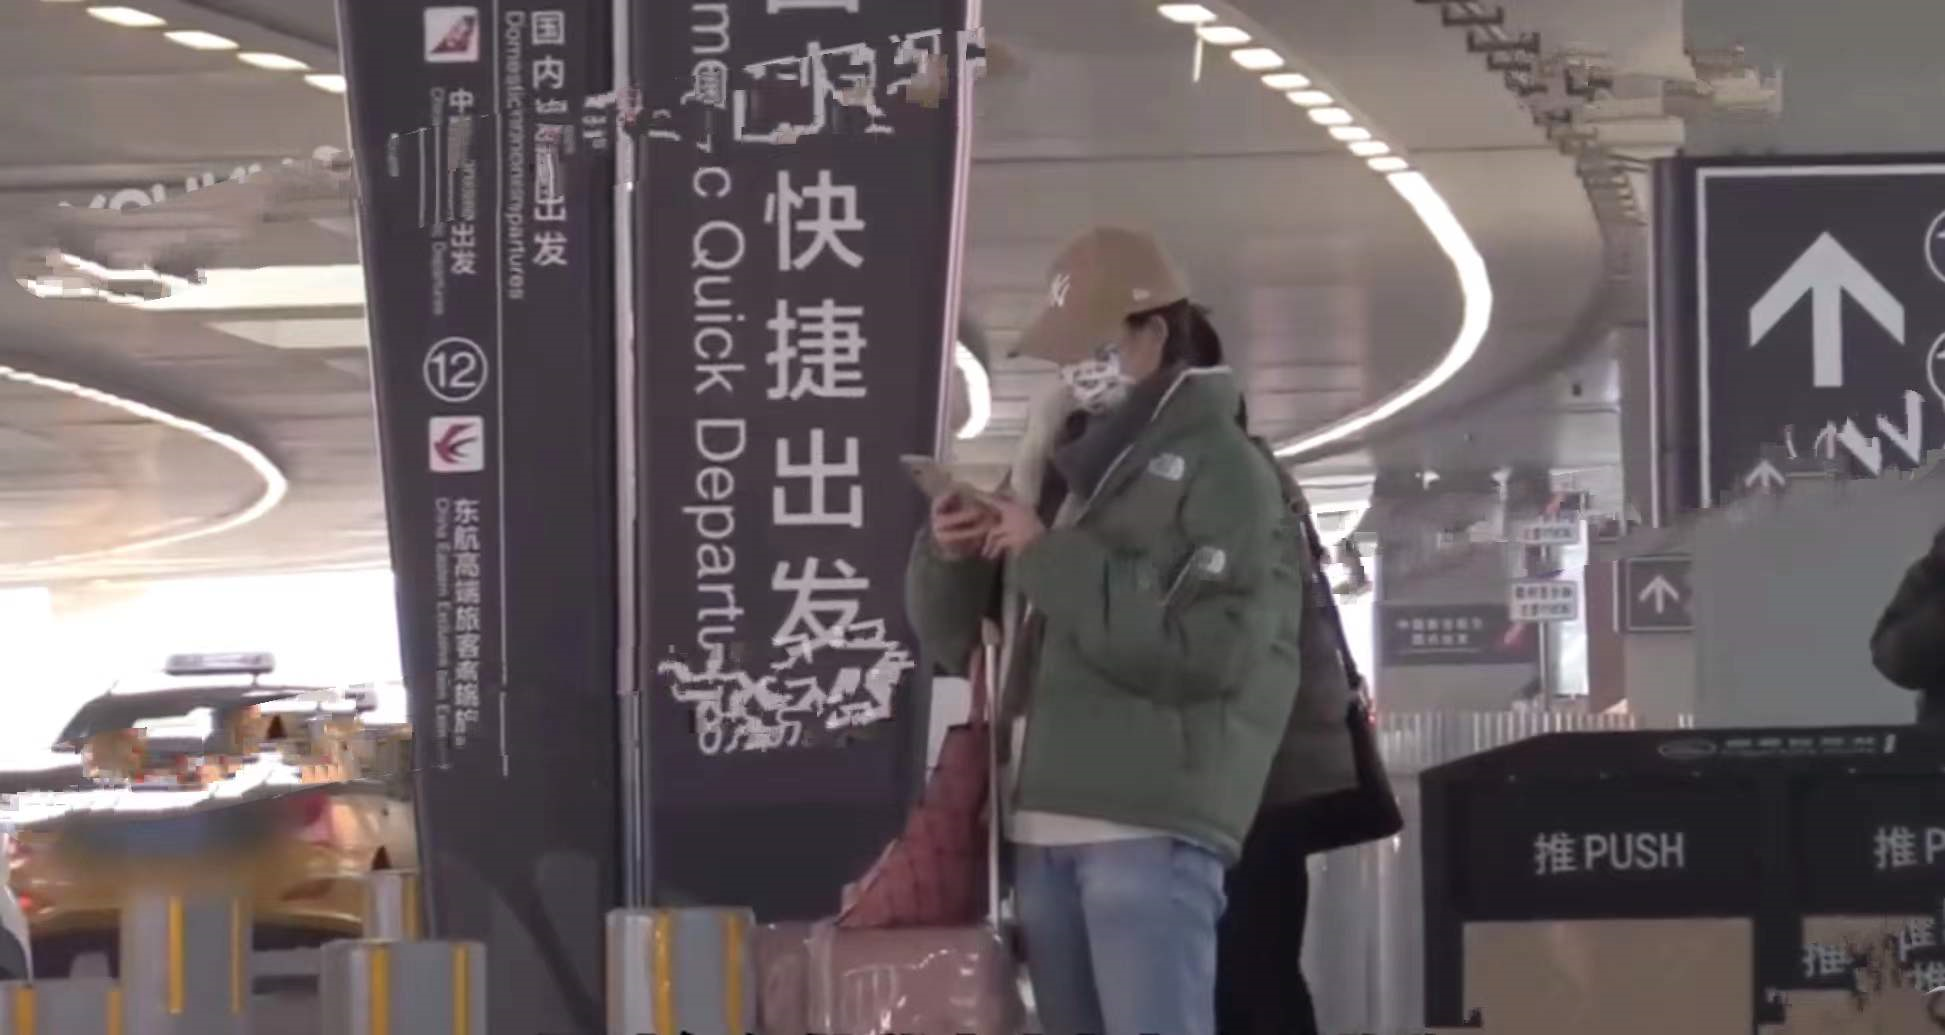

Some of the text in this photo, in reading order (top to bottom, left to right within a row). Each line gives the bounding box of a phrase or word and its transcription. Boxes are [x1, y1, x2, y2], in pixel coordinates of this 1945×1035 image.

[691, 220, 746, 393] Quick
[431, 352, 476, 389] 12
[1533, 831, 1685, 876] 推 PUSH
[1873, 826, 1918, 870] 推
